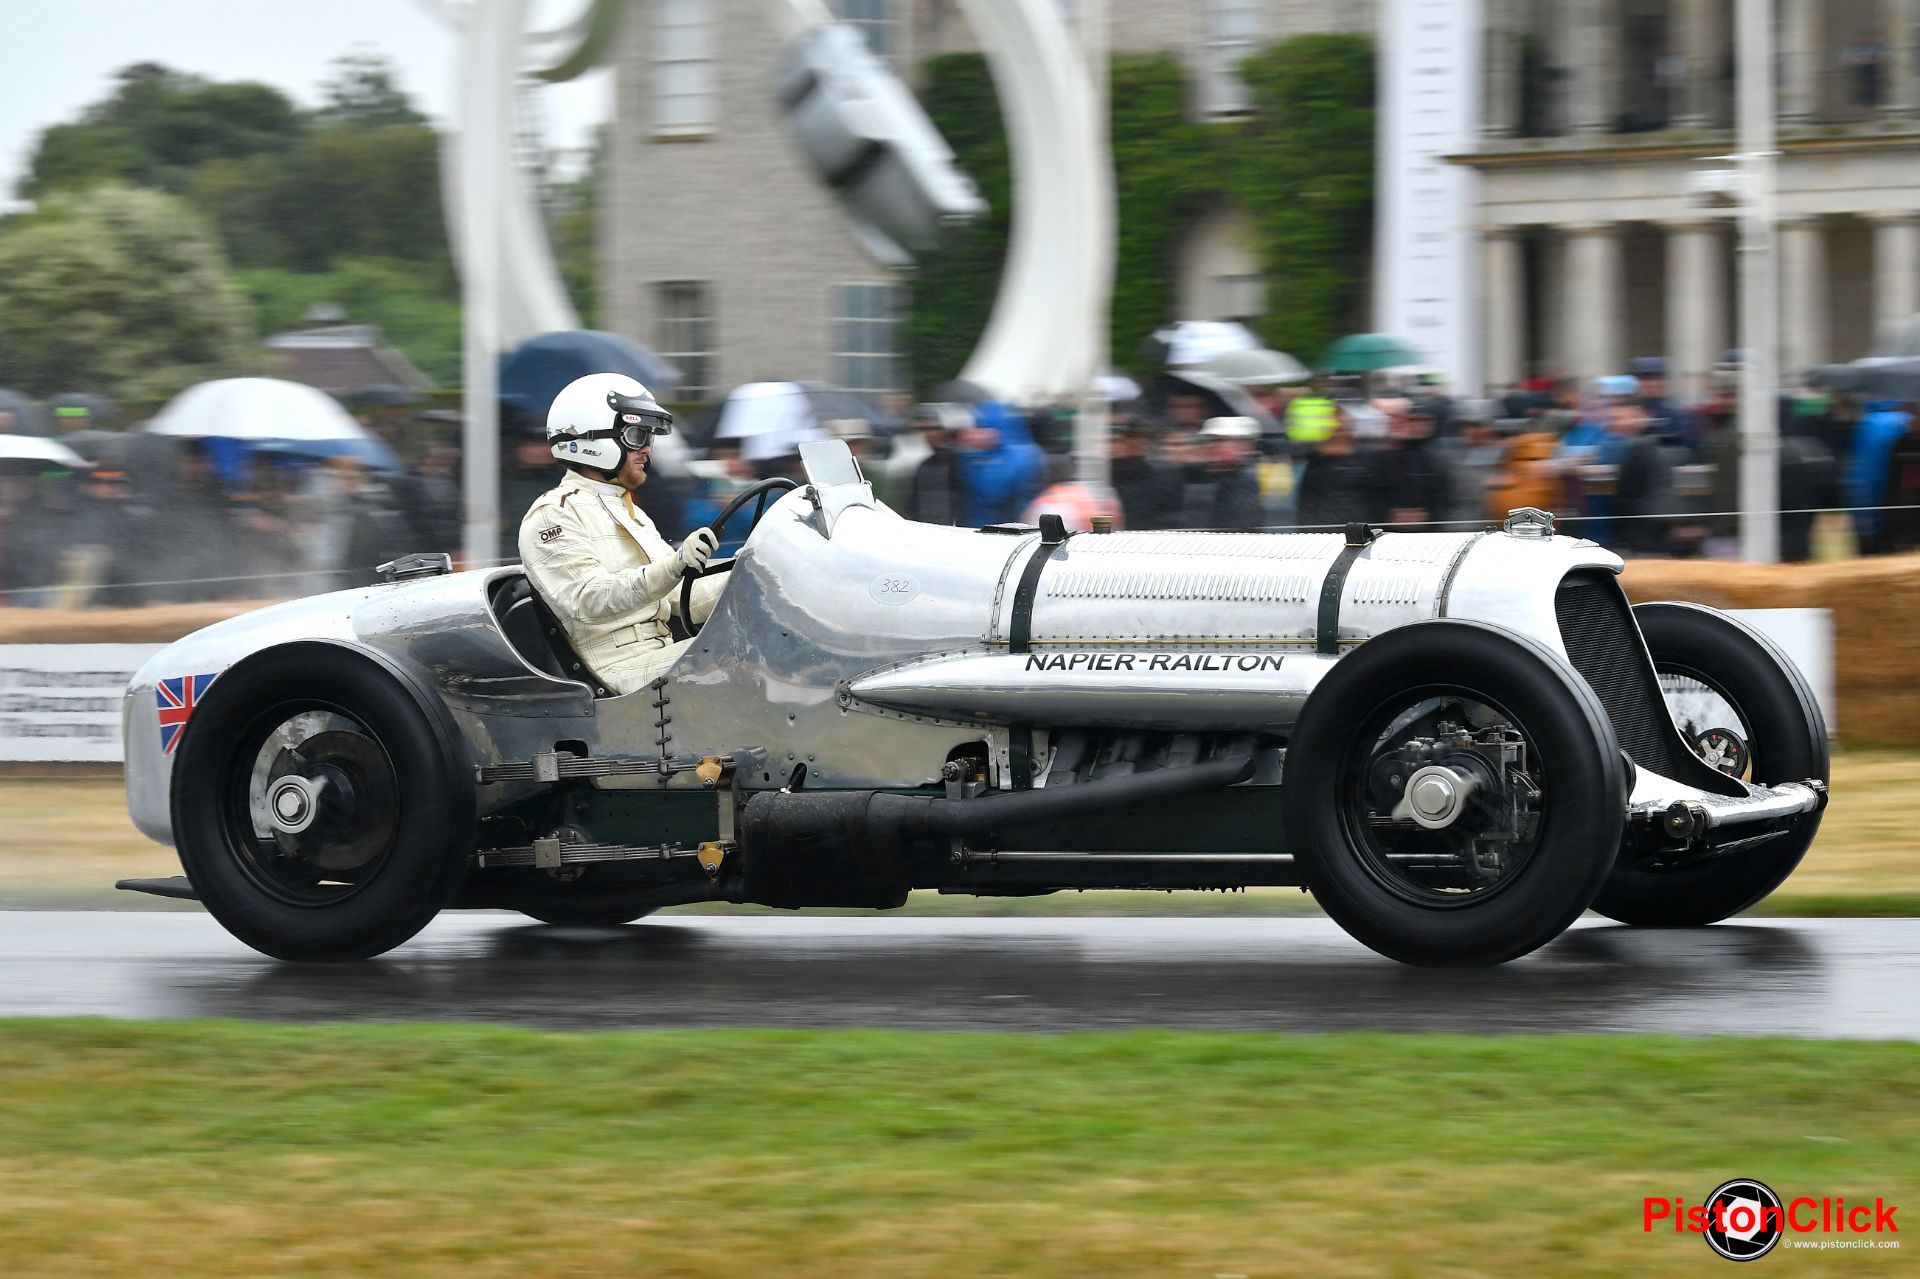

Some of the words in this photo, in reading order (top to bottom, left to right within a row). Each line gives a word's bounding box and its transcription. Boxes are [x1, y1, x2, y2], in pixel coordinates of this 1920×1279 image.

[540, 527, 563, 541] OMP
[880, 578, 909, 593] 382
[1025, 653, 1285, 671] NAPIER-RAILTON
